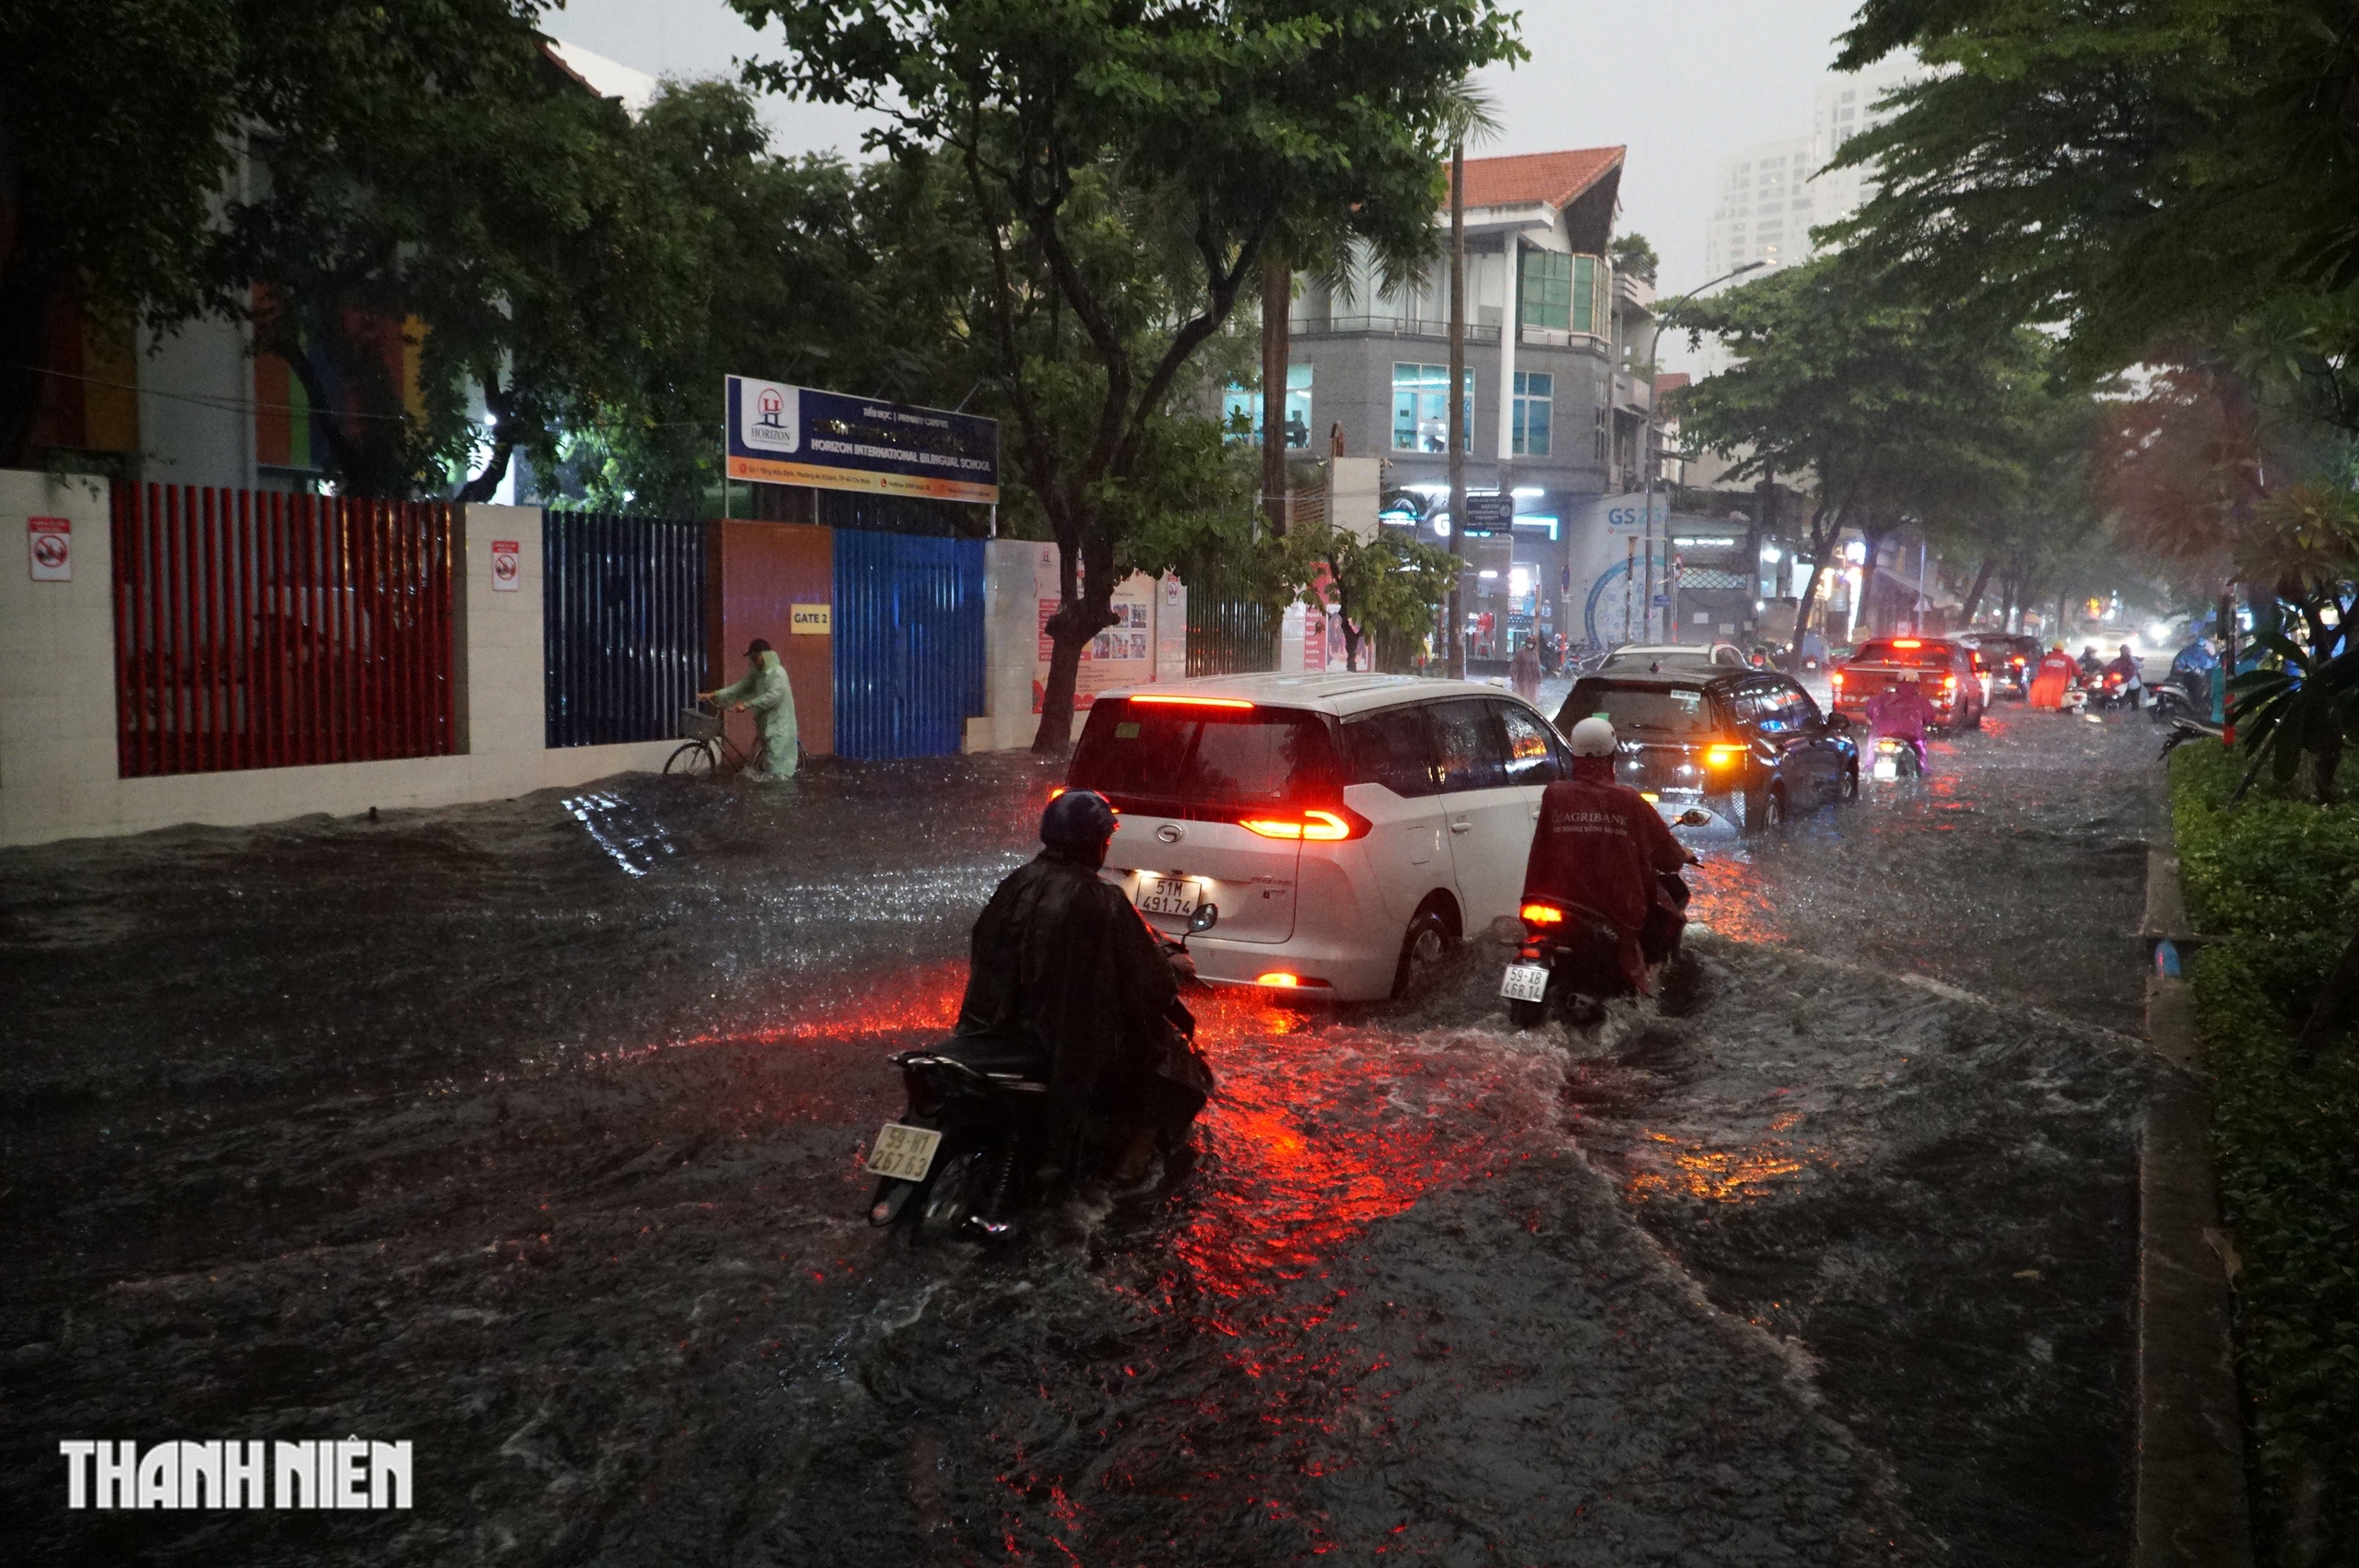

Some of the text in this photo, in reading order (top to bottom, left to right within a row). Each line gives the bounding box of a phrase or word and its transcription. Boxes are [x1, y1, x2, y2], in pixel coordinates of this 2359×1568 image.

[751, 427, 791, 441] HORIZON
[811, 438, 992, 472] HORIZON INTERNATIONAL BILINGUAL SCHOOL
[793, 613, 827, 624] GATE 2
[1563, 812, 1629, 826] AGRIBANK
[1156, 880, 1183, 897] 51M
[1143, 895, 1191, 915] 491.74
[1504, 982, 1541, 1000] 468.14
